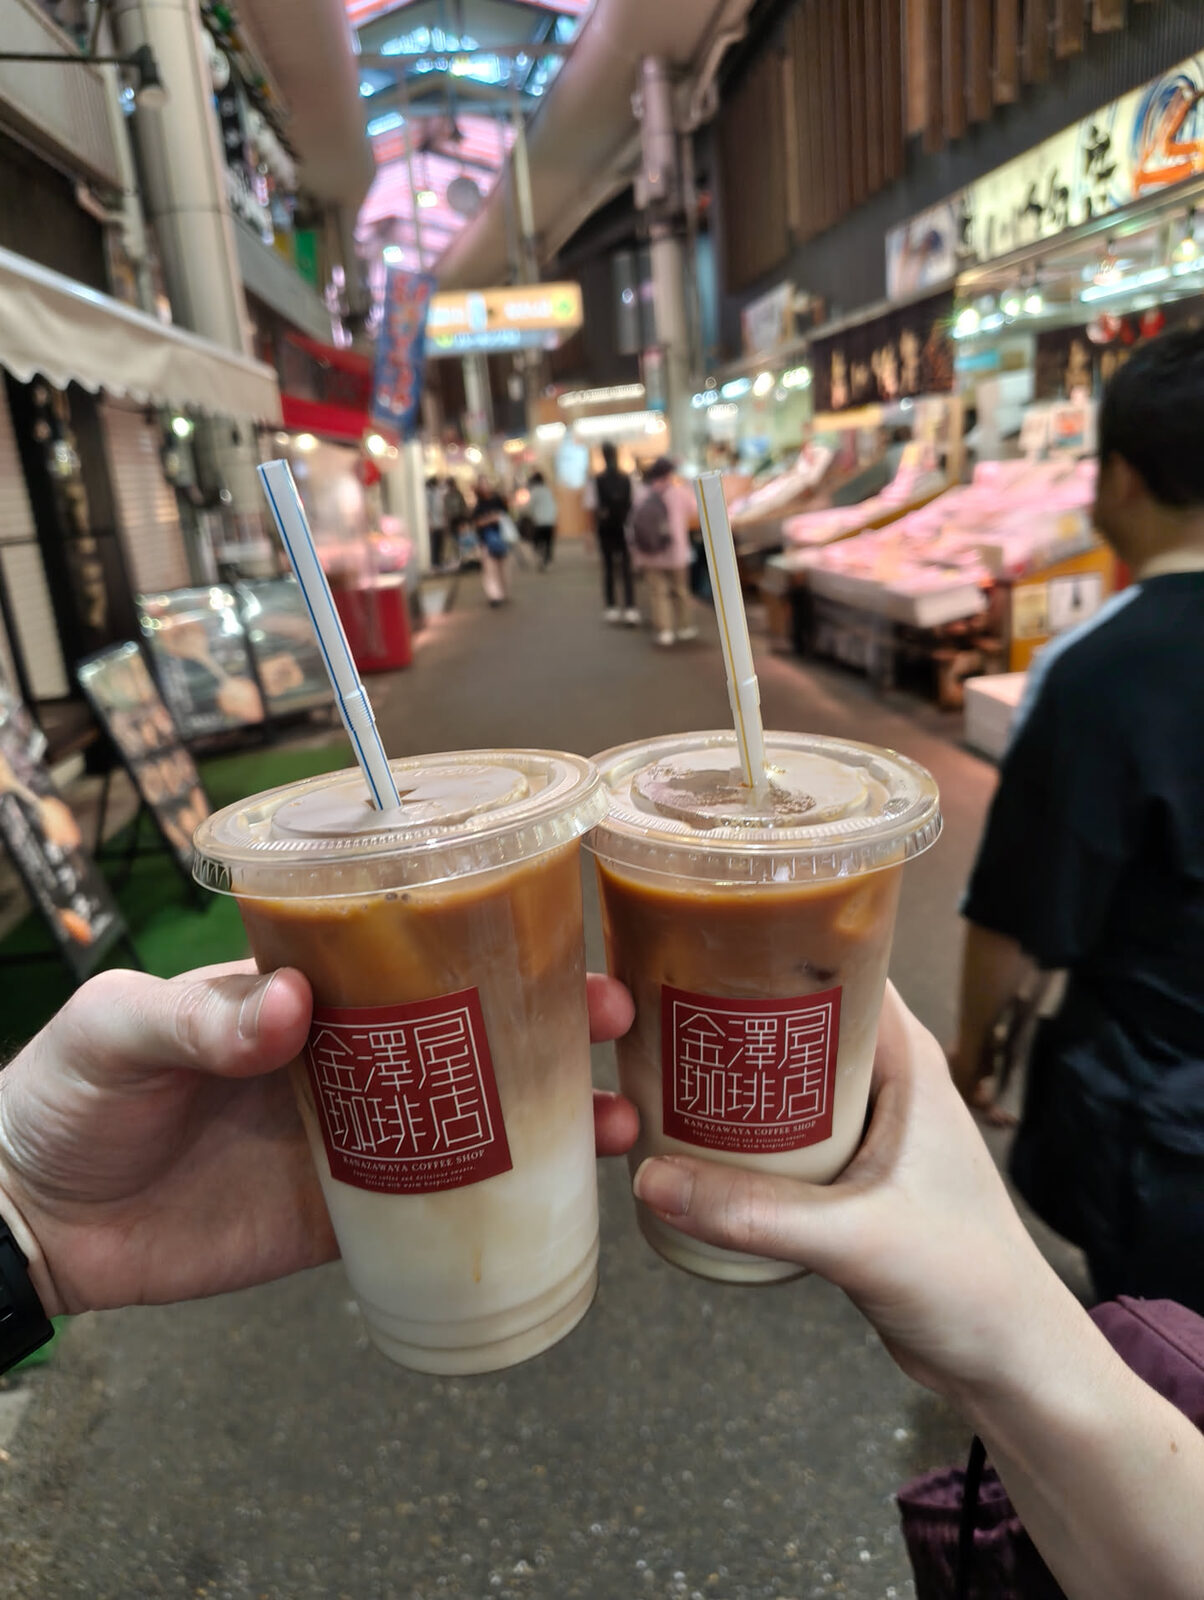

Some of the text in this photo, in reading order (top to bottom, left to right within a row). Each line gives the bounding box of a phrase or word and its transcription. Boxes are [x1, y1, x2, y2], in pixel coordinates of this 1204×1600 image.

[311, 1016, 474, 1093] 金澤屋
[679, 1009, 827, 1071] 金澤屋
[324, 1084, 484, 1155] 珈琲店
[679, 1062, 823, 1121] 珈琲店
[683, 1117, 817, 1136] KANAZAWAYA COFFEE SHOP
[342, 1148, 486, 1173] KANAZAWAYA COFFEE SHOP
